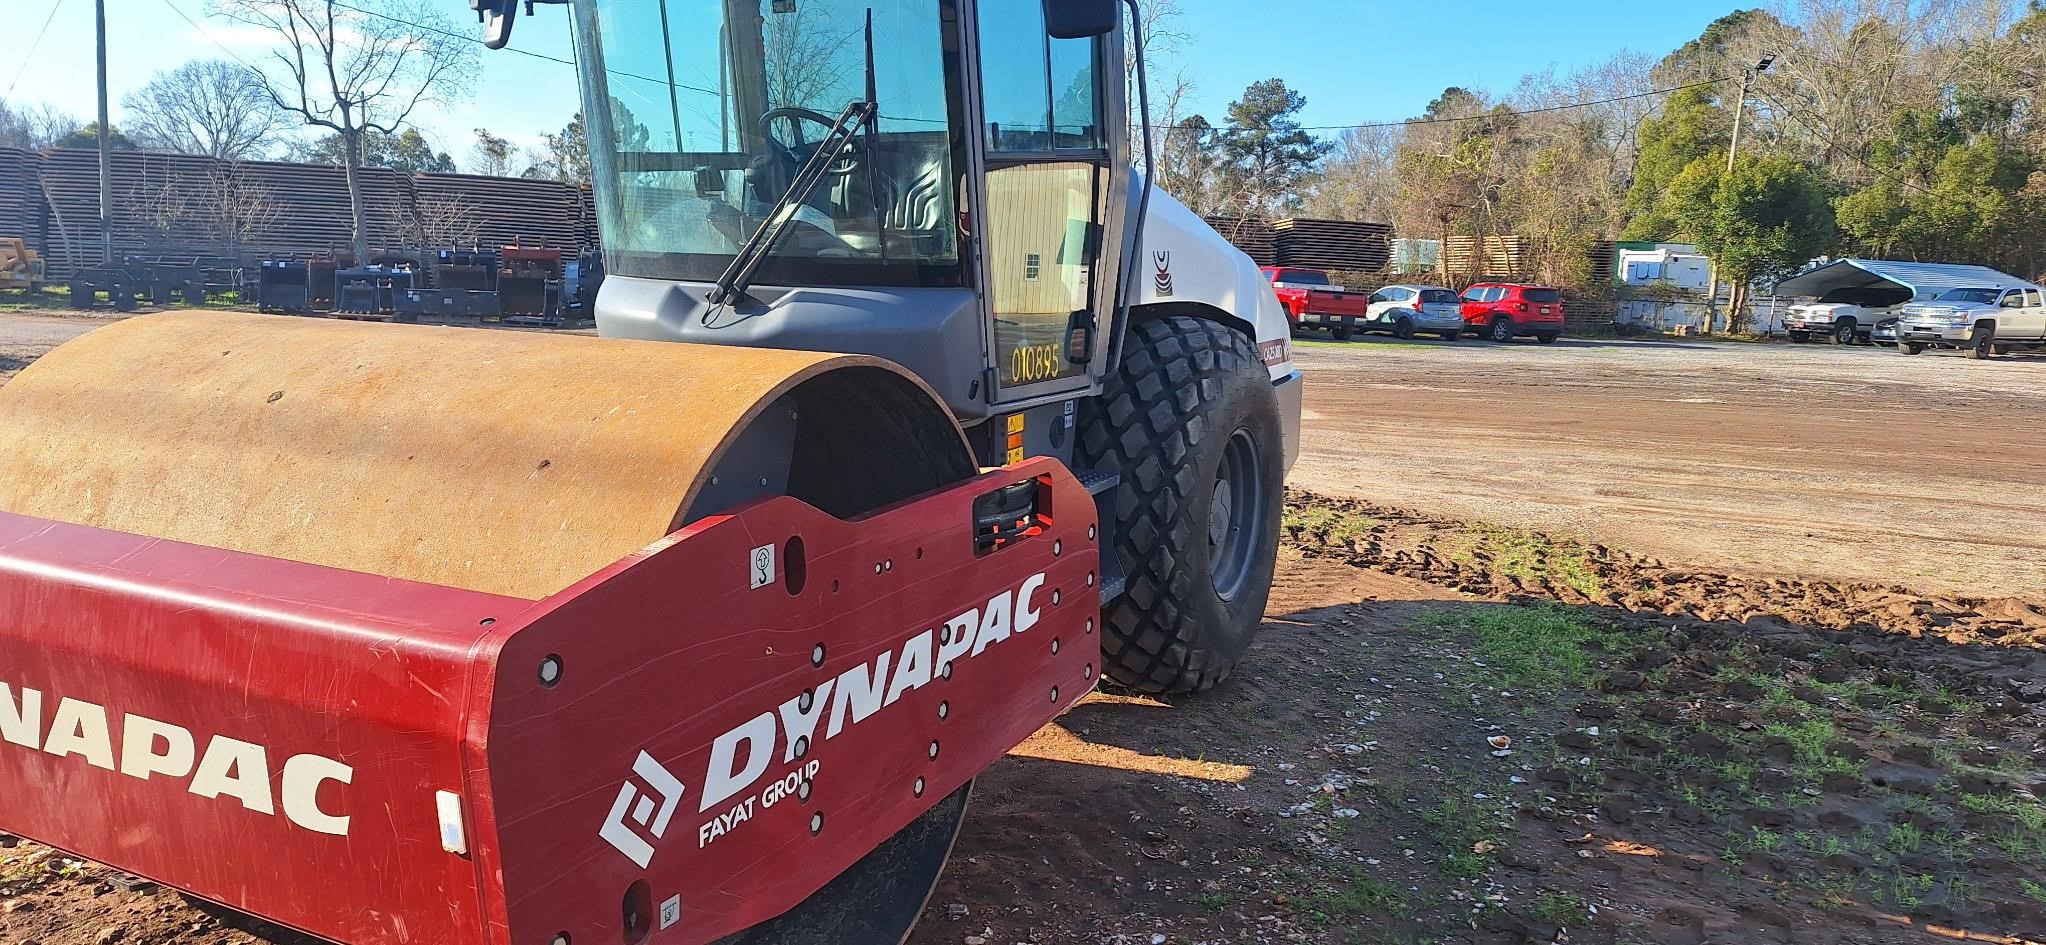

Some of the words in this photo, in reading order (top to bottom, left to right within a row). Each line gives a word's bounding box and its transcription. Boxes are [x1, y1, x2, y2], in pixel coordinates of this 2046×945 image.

[1011, 344, 1059, 382] 010895
[699, 573, 1046, 813] DYNAPAC
[699, 796, 756, 848] FAYAT
[761, 759, 819, 808] GROUP
